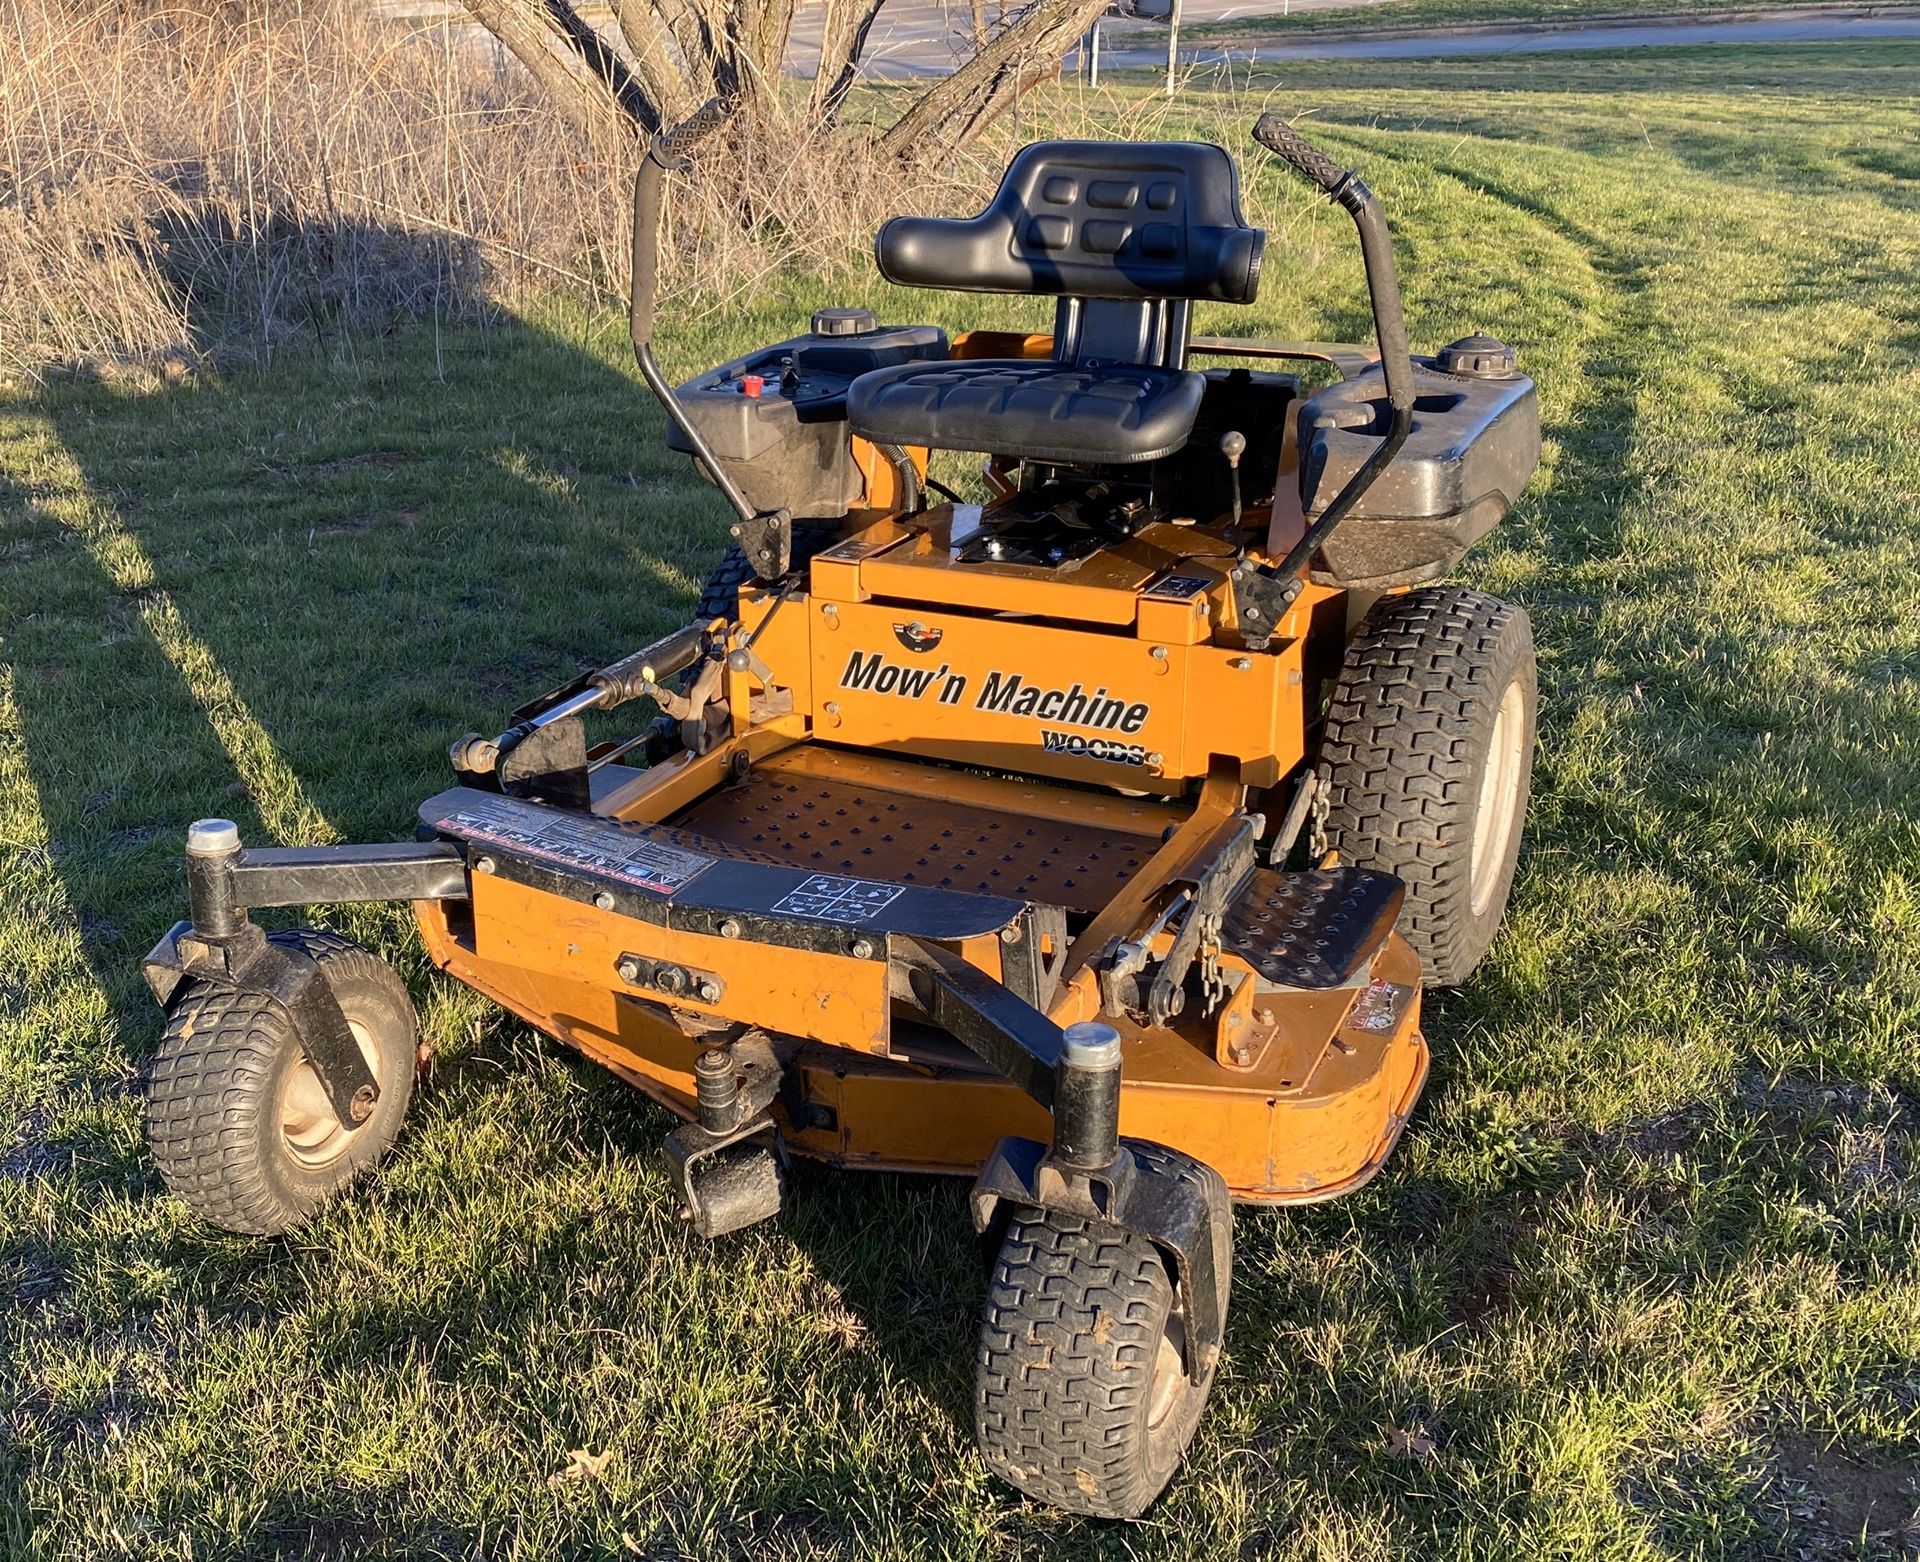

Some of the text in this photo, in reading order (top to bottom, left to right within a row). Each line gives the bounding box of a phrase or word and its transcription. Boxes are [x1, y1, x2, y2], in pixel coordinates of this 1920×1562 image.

[840, 650, 1149, 733] Mow'n Machine
[1040, 730, 1145, 766] WOODS
